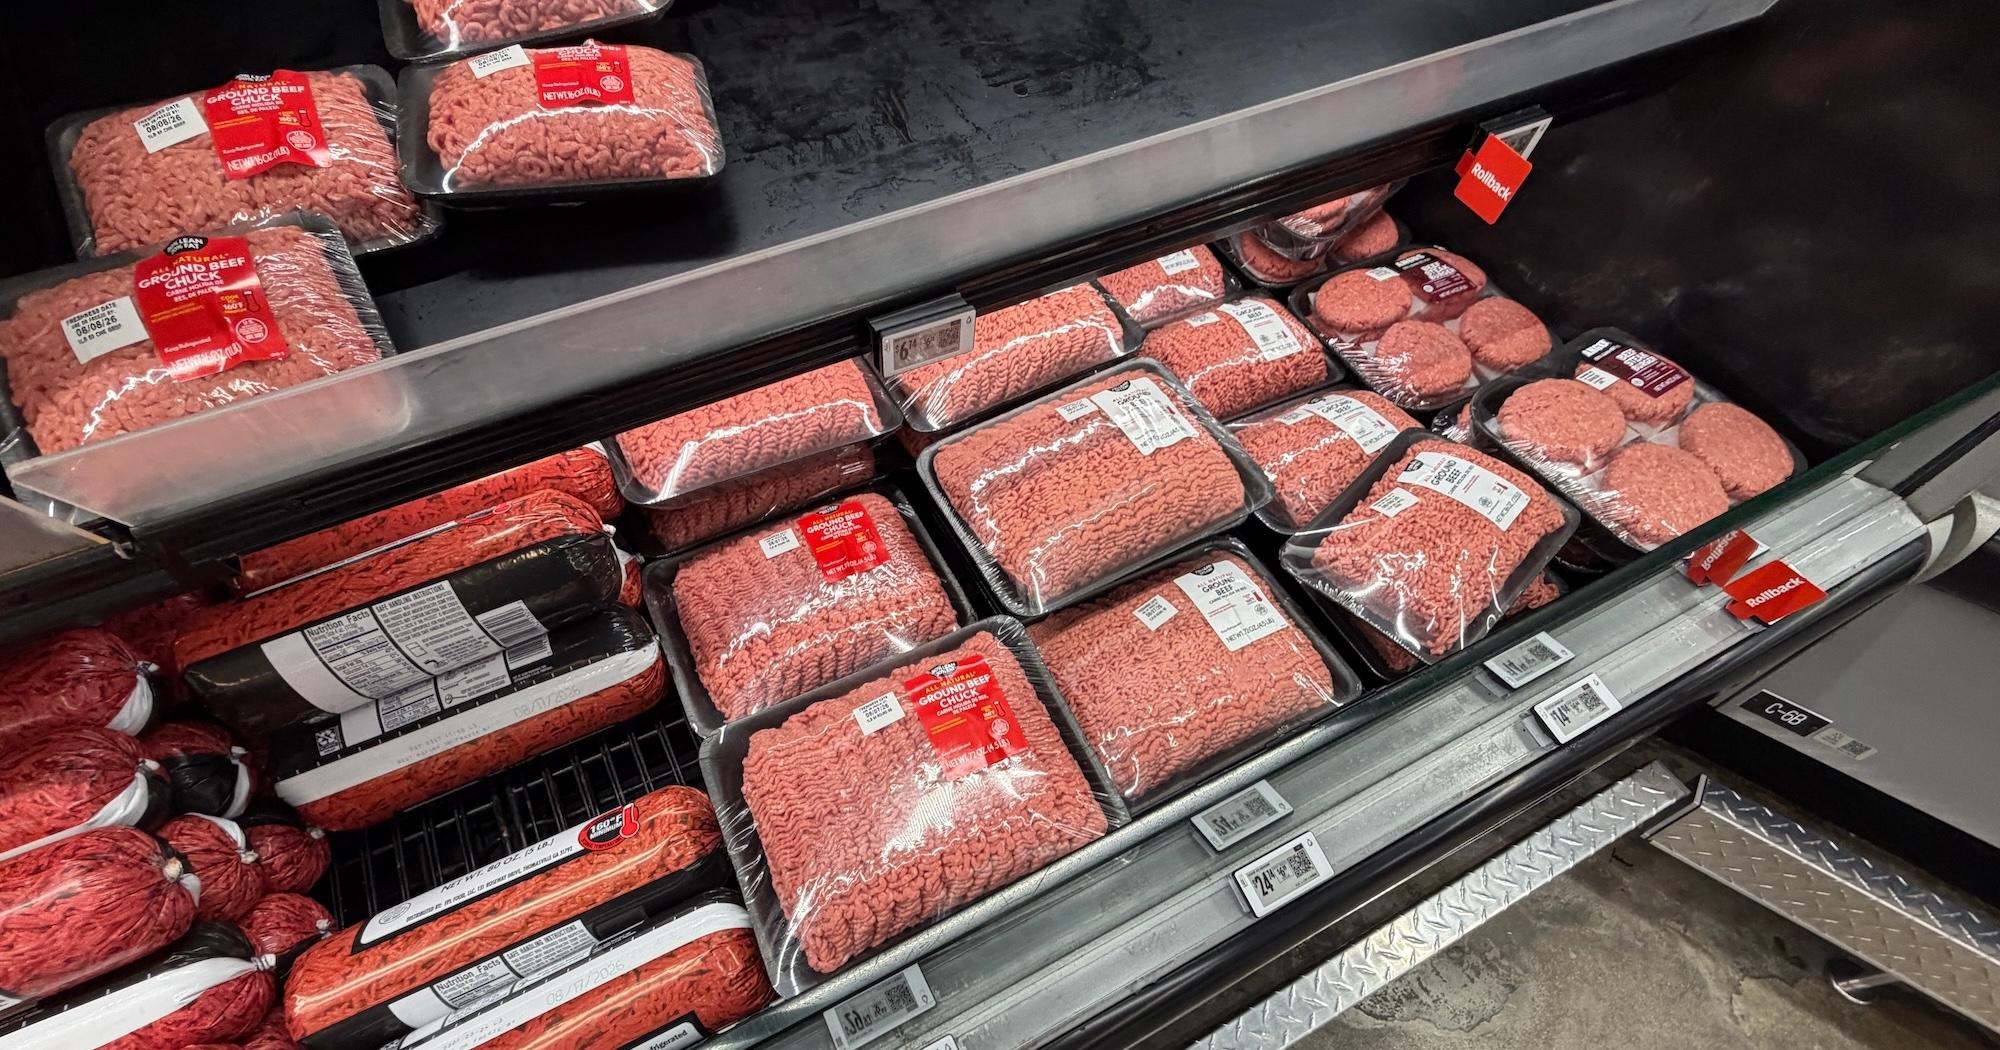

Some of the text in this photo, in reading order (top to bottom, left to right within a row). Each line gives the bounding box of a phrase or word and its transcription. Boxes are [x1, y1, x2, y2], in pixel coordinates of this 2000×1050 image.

[207, 85, 305, 104] GROUND BEEF
[231, 93, 281, 106] CHUCK
[146, 114, 182, 133] 08/08/26
[1471, 162, 1512, 202] Rollback
[183, 243, 200, 251] FAT
[138, 257, 246, 288] GROUND BEEF
[164, 270, 221, 290] CHUCK
[101, 302, 116, 312] DATE
[75, 315, 118, 337] 08/08/26
[1430, 459, 1457, 486] GROUND
[807, 517, 844, 534] GROUND
[845, 511, 864, 521] BEEF
[823, 522, 854, 536] CHUCK
[1201, 576, 1236, 593] GROUND
[1215, 585, 1234, 596] BEEF
[1745, 577, 1806, 608] Rollback
[375, 604, 388, 613] SAFE
[412, 584, 445, 600] INSTRUCTIONS
[307, 610, 370, 637] Nutrition Facts
[919, 674, 991, 706] GROUND BEEF
[925, 672, 975, 694] ALL NATURAL
[939, 689, 980, 708] CHUCK
[590, 821, 623, 840] MINIMUM
[441, 879, 463, 893] NET
[487, 862, 501, 872] 80
[436, 959, 501, 991] Nutrition Facts
